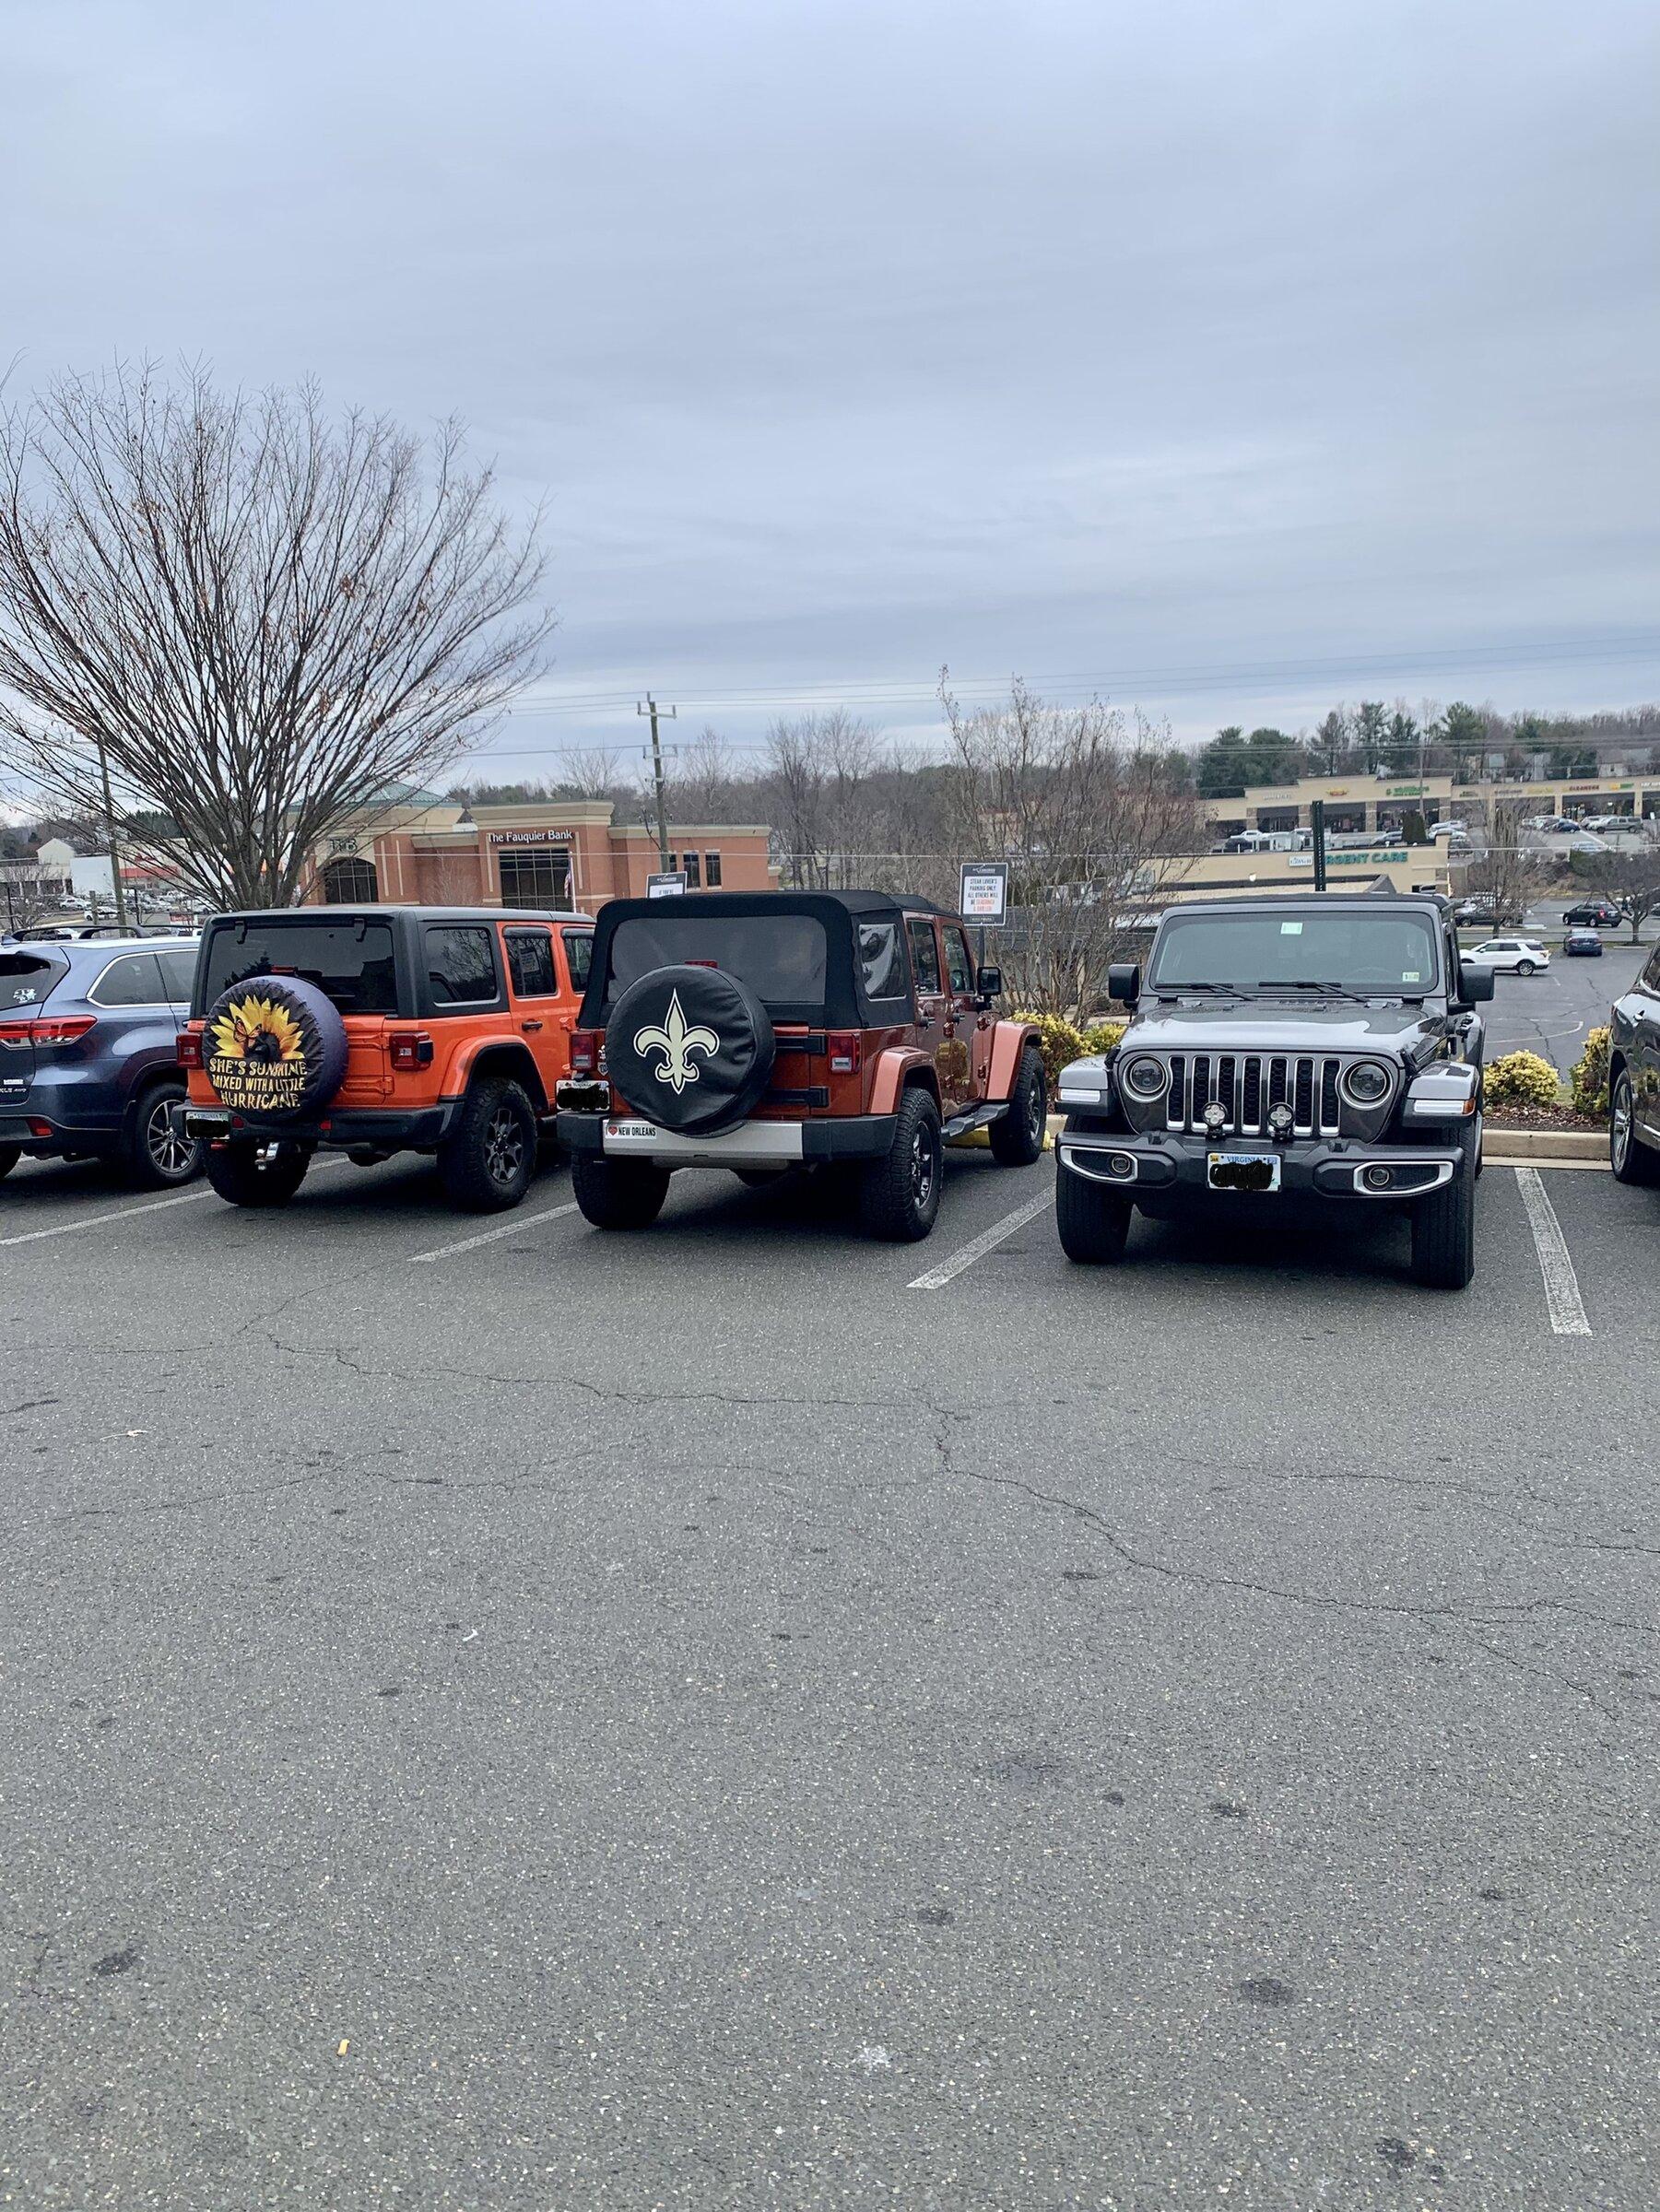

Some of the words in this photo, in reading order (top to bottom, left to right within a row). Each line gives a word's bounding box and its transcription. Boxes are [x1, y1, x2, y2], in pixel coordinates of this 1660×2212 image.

[487, 832, 504, 842] The
[506, 830, 546, 843] Fauquier
[547, 830, 573, 841] Bank
[1324, 853, 1369, 865] RGENT
[1371, 851, 1409, 864] CARE
[209, 1058, 247, 1076] SHE'S
[249, 1062, 308, 1077] SUNSHINE
[211, 1075, 242, 1090] MIXED
[245, 1077, 267, 1091] WITH
[276, 1077, 306, 1092] LITTLE
[618, 1126, 630, 1135] NEW
[631, 1126, 656, 1137] ORLEANS
